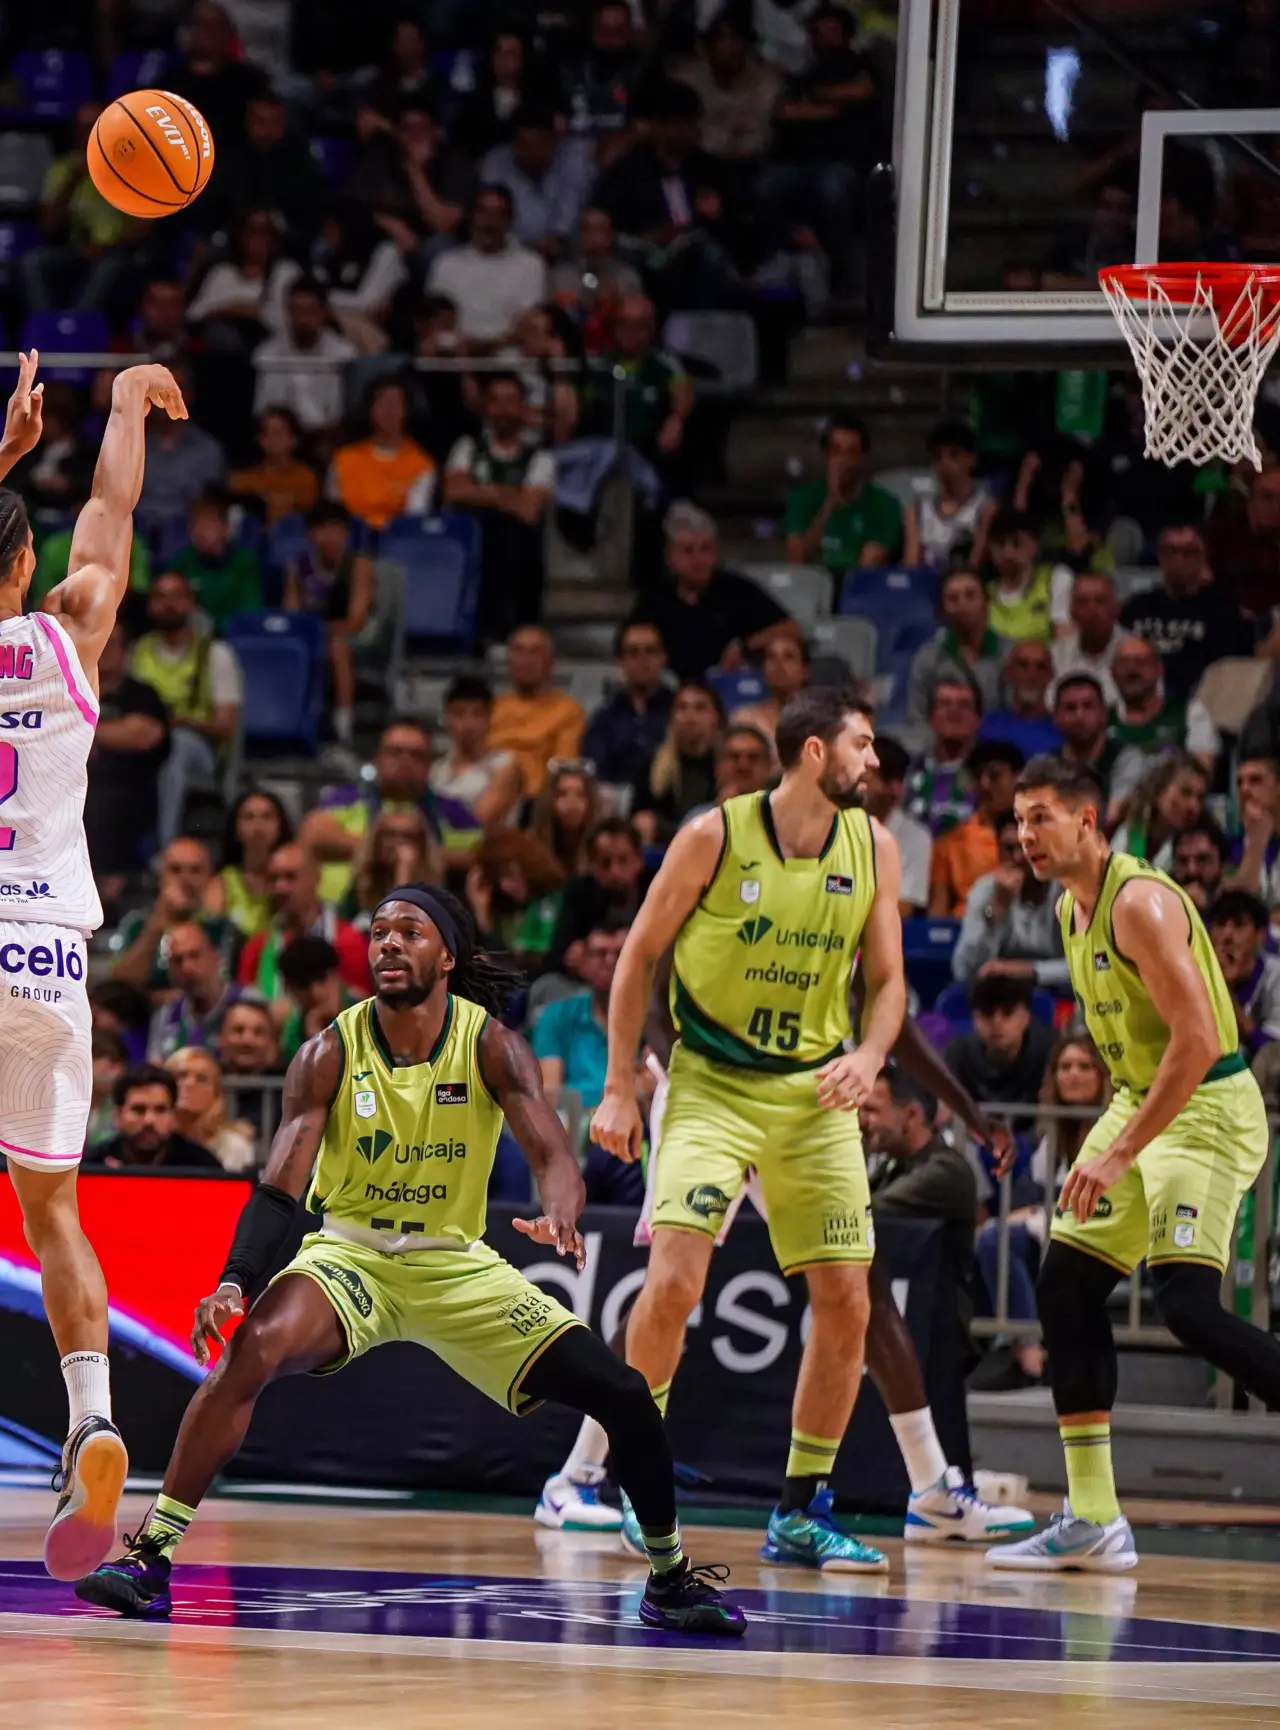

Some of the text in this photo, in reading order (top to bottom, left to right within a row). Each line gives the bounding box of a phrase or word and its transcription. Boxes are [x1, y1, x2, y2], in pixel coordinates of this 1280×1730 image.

[775, 928, 845, 954] Unicaja
[10, 985, 62, 1003] GROUP
[748, 1007, 801, 1051] 45
[394, 1138, 466, 1164] Unicaja
[365, 1181, 447, 1204] málaga
